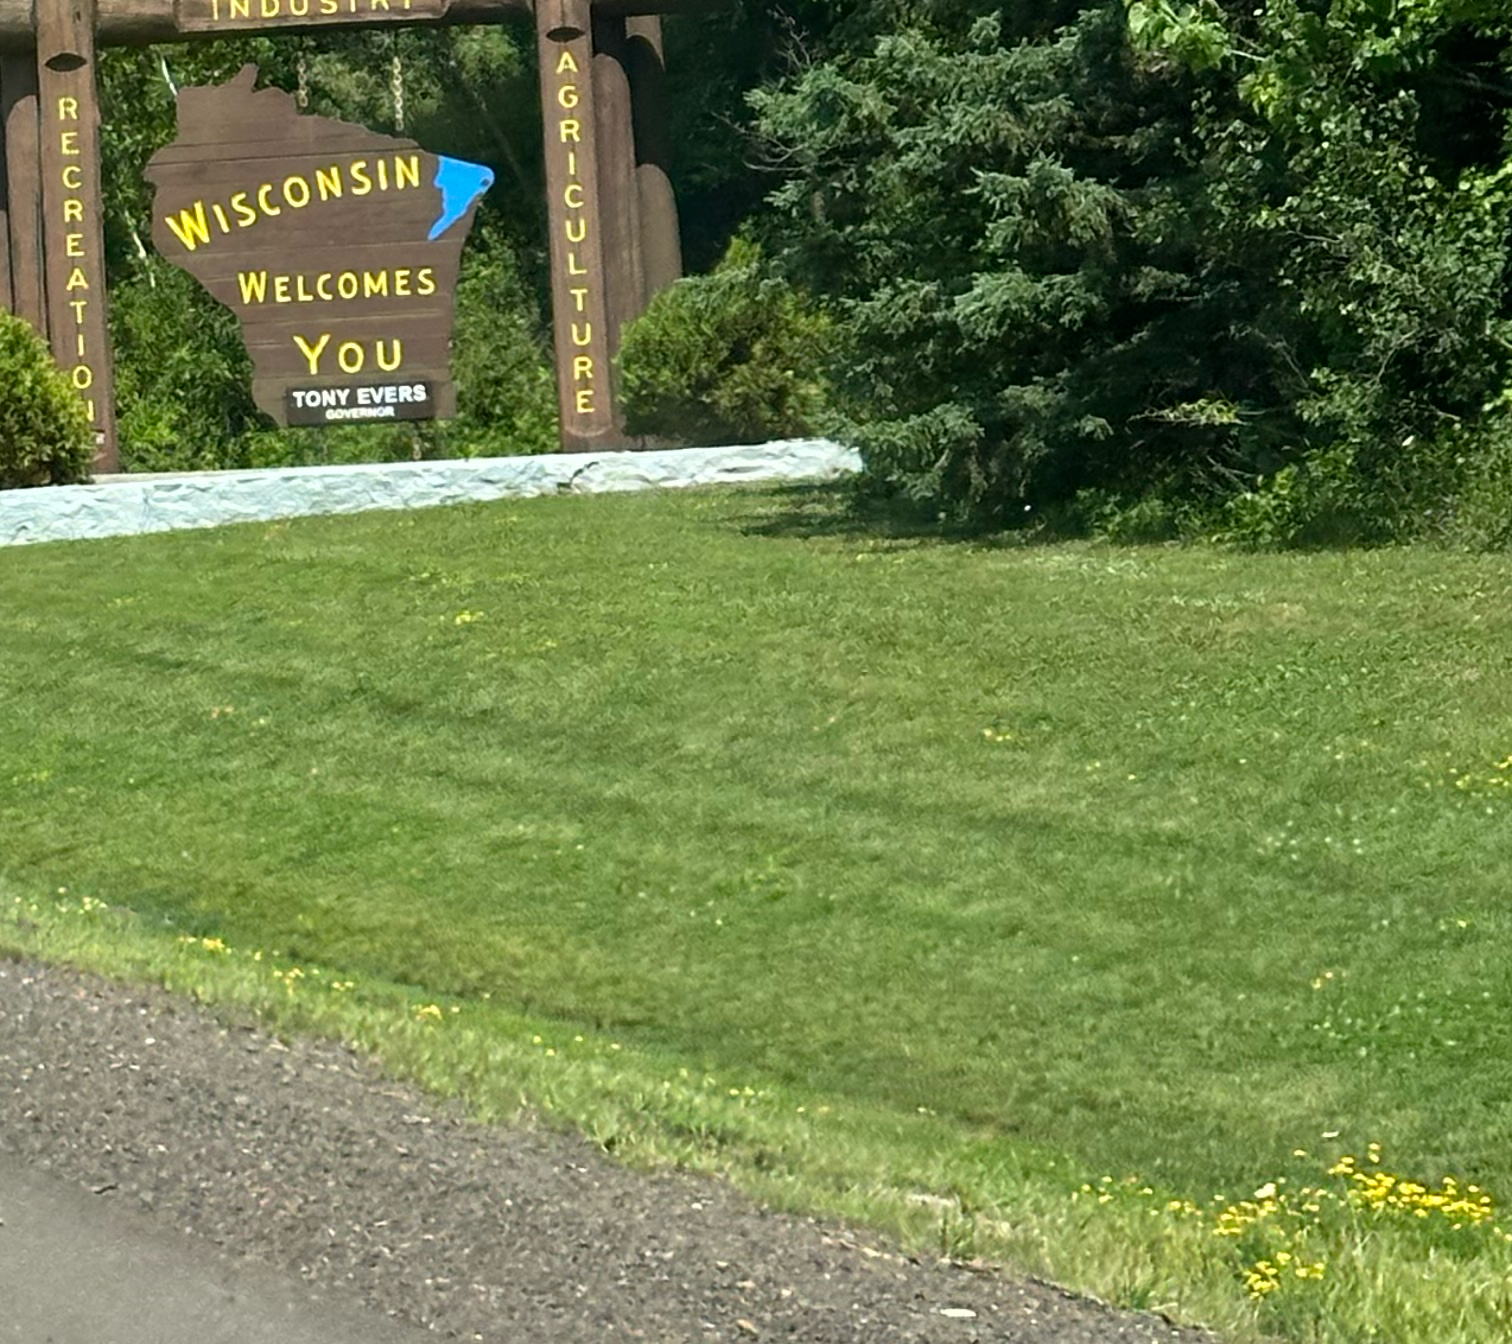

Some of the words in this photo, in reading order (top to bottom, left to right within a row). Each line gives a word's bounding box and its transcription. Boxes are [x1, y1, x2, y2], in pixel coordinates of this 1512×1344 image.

[165, 155, 420, 251] WISCONSIN
[556, 52, 595, 414] AGRICULTURE
[238, 268, 436, 304] WELCOMES
[292, 334, 403, 375] YOU
[292, 388, 350, 408] TONY
[356, 384, 427, 406] EVERS
[325, 405, 396, 420] GOVERNOR
